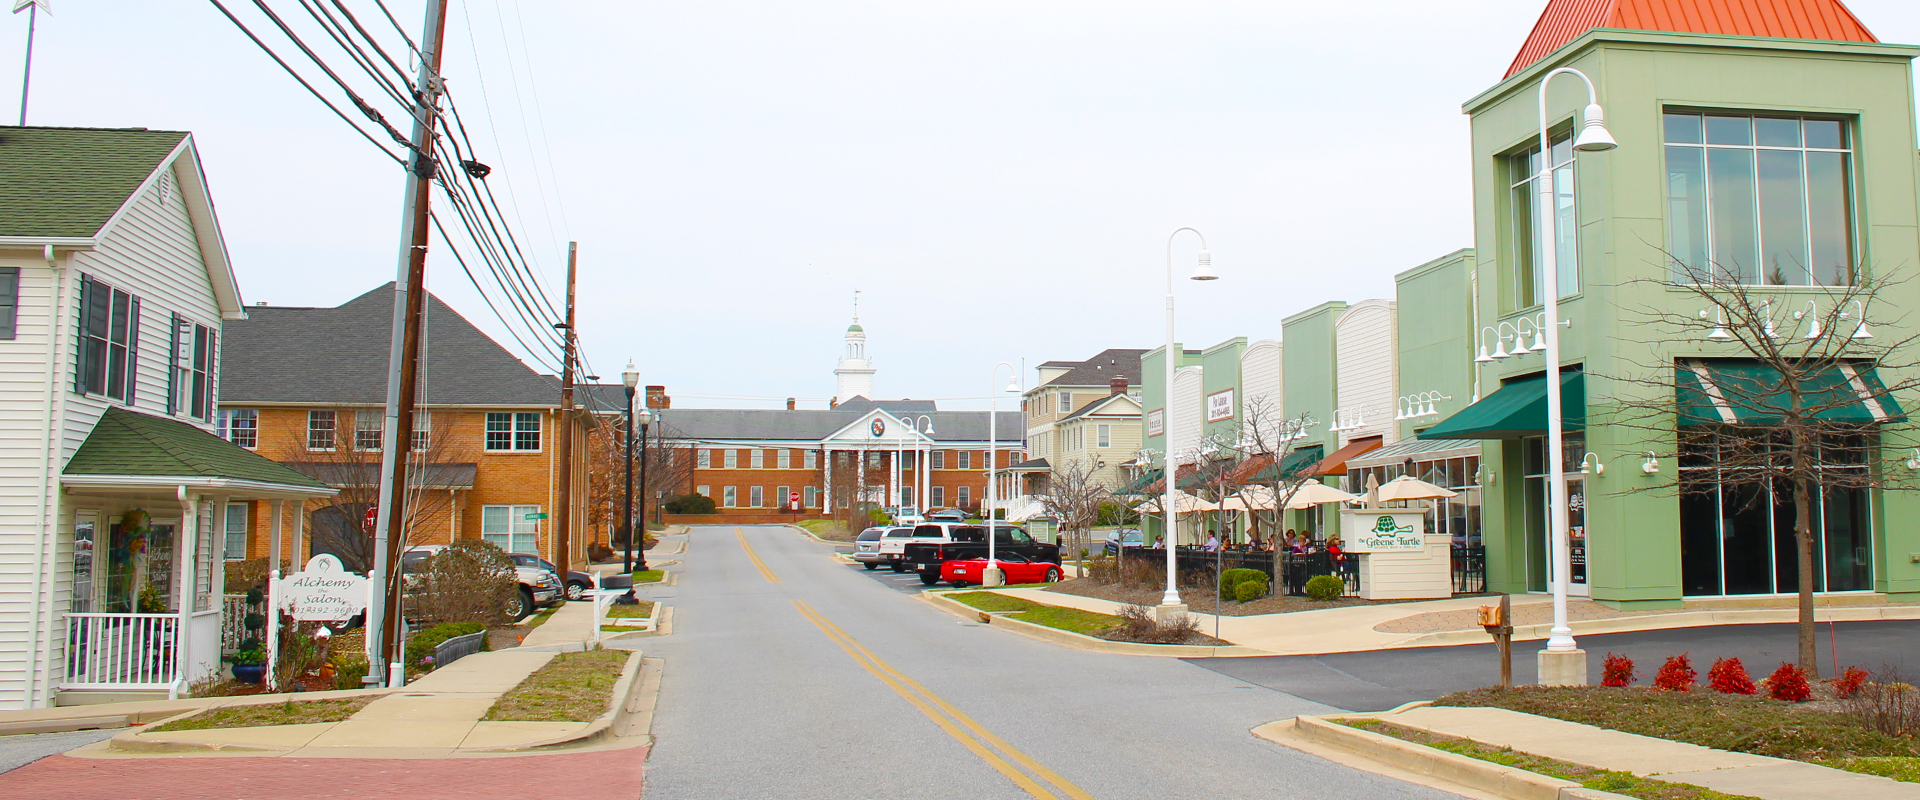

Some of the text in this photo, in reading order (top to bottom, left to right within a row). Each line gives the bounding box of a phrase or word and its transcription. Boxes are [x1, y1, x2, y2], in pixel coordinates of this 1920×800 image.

[1366, 537, 1394, 548] Greene
[1397, 537, 1420, 545] Turtle
[293, 577, 355, 589] Alchemy
[303, 594, 344, 604] Salon
